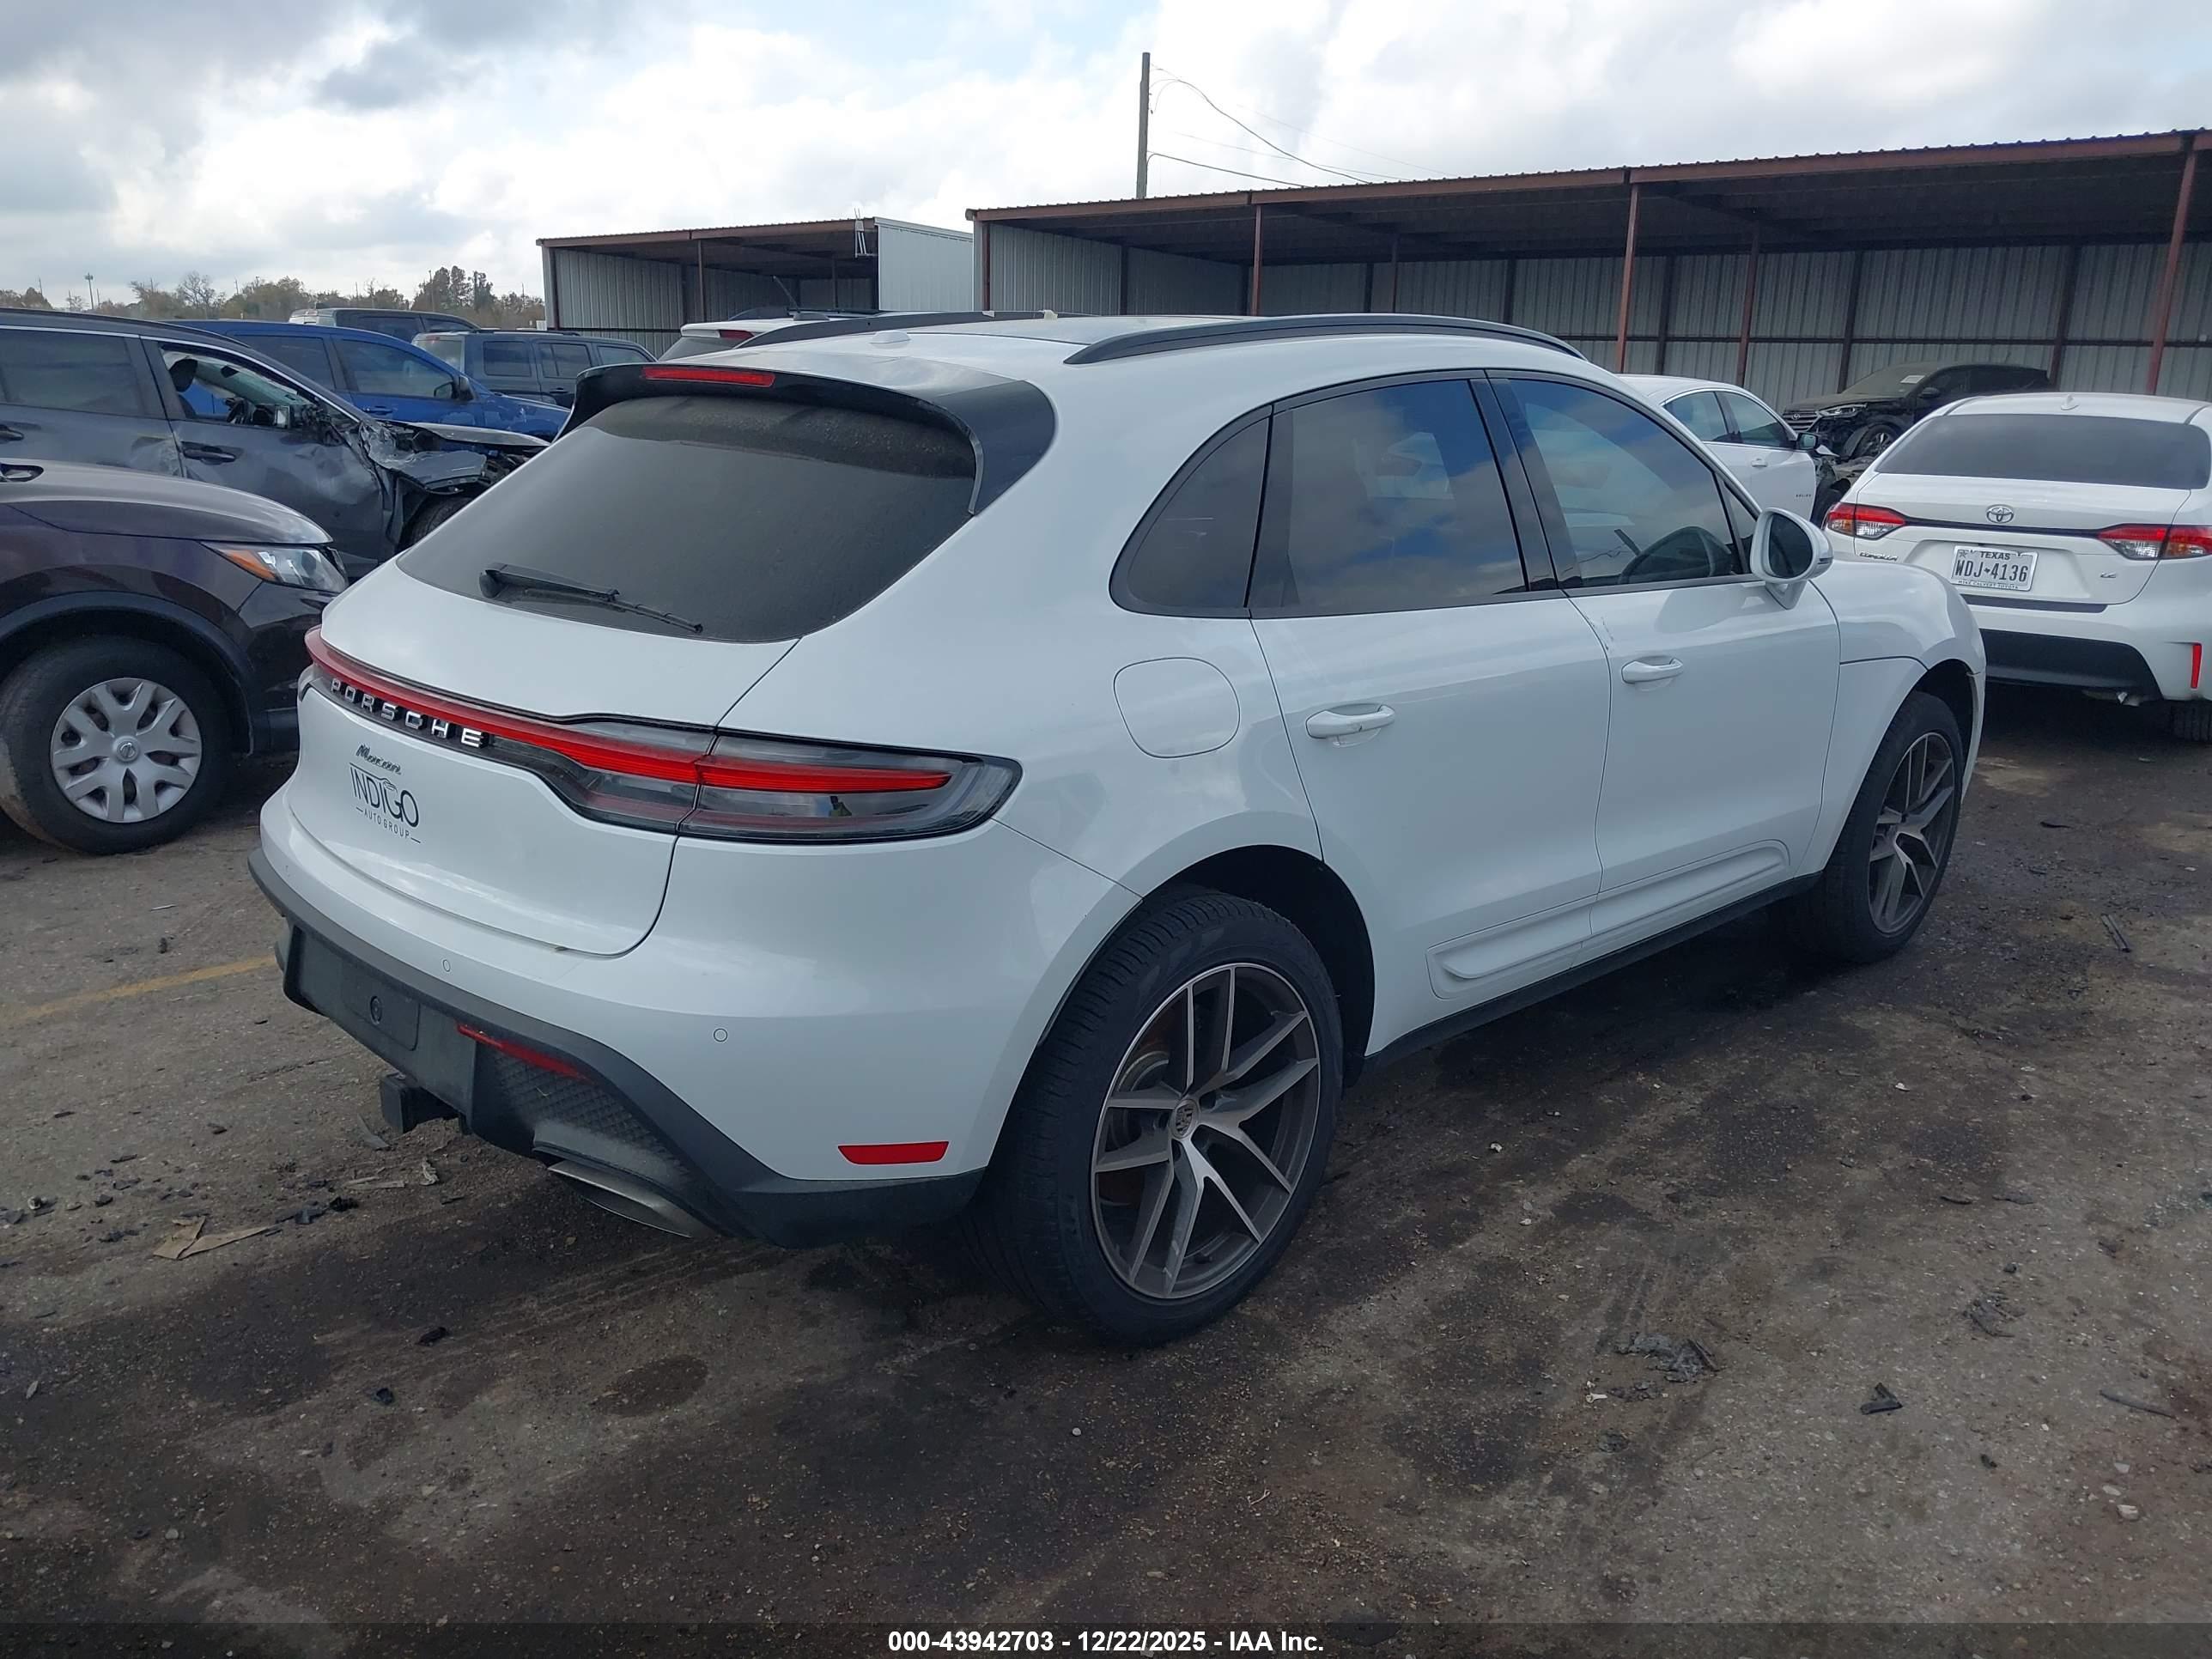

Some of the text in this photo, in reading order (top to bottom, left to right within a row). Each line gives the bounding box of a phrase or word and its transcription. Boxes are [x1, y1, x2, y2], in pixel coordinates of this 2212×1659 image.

[1980, 550, 2010, 561] TEXAS
[330, 678, 486, 749] PORSCHE
[356, 744, 402, 775] Macan
[350, 766, 419, 828] INDIGO
[364, 808, 410, 839] AUTO GROUP
